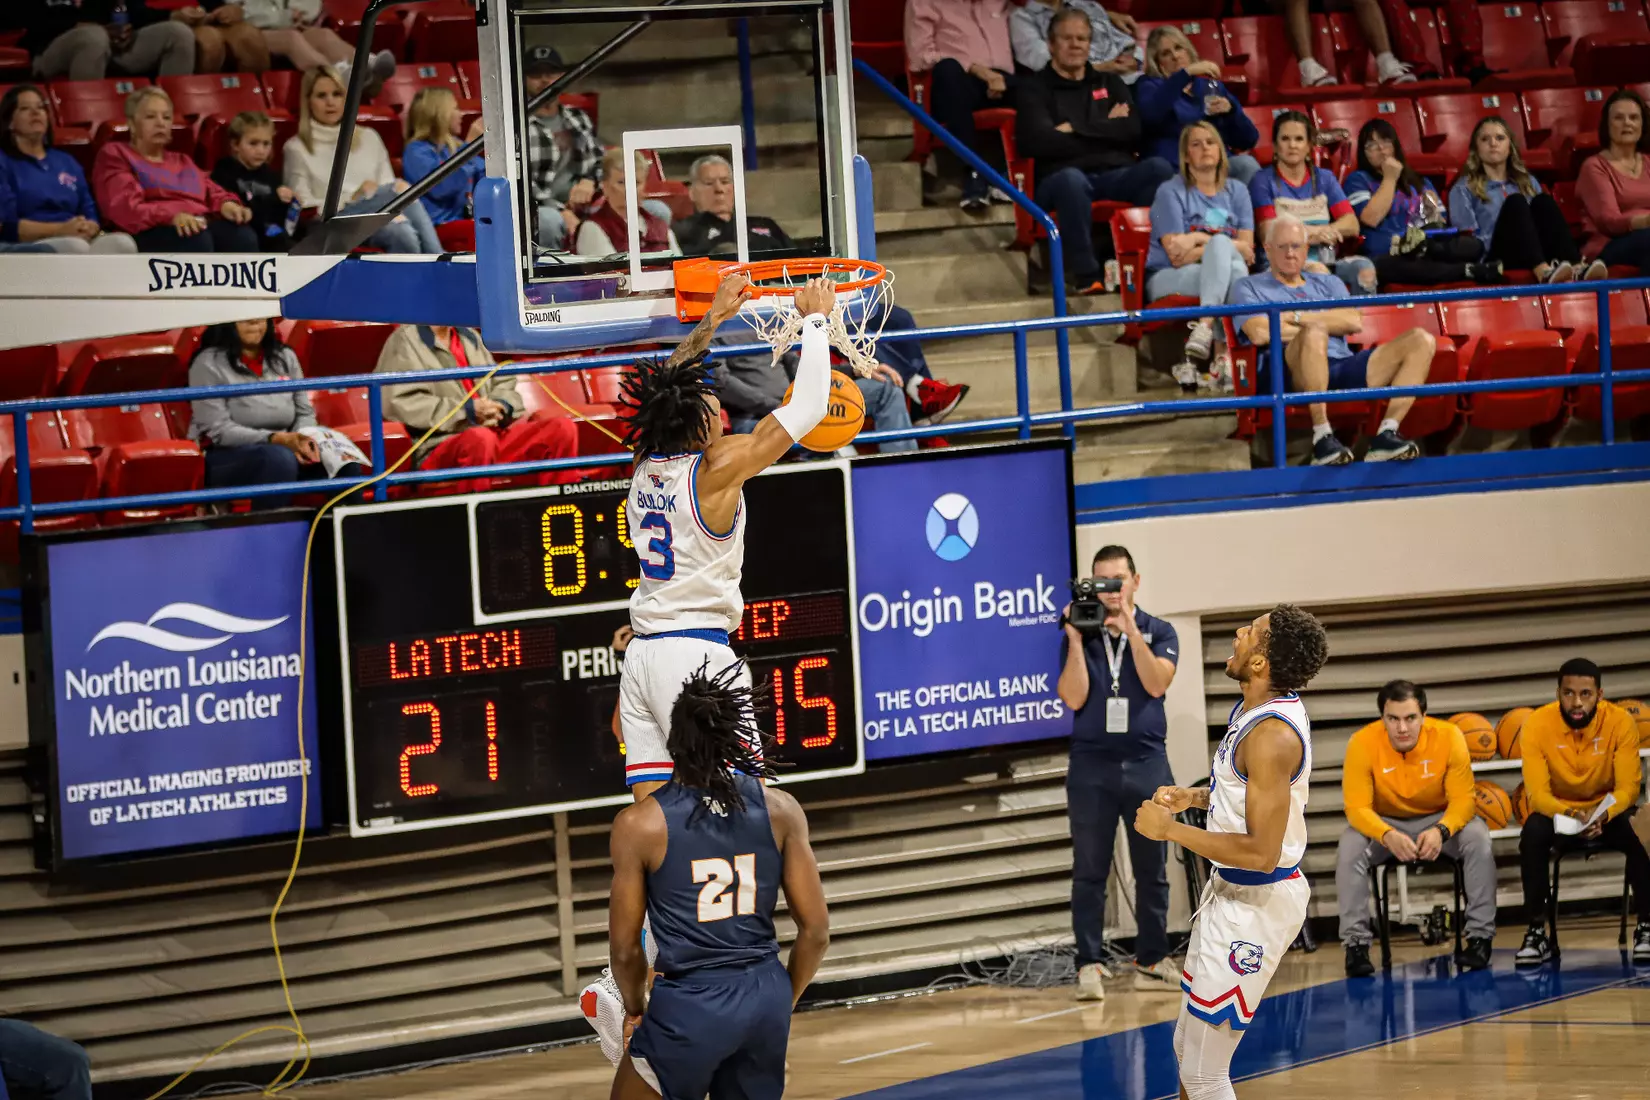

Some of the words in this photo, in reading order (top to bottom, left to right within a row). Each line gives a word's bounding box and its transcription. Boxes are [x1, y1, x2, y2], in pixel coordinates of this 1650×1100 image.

[148, 257, 277, 293] SPALDING
[524, 309, 561, 326] SPALDING
[563, 478, 634, 495] DAKTRONIC
[639, 511, 676, 581] 3
[859, 586, 964, 638] Origin
[973, 573, 1057, 620] Bank
[65, 661, 181, 700] Northern
[187, 648, 302, 687] Louisiana
[389, 628, 521, 680] LATECH
[89, 693, 190, 737] Medical
[195, 690, 282, 726] Center
[773, 656, 837, 749] 15
[875, 688, 912, 712] THE
[915, 679, 996, 708] OFFICIAL
[999, 673, 1050, 698] BANK
[864, 719, 890, 741] OF
[894, 716, 918, 738] LA
[919, 711, 968, 735] TECH
[971, 698, 1065, 729] ATHLETICS
[400, 701, 498, 797] 21
[66, 777, 147, 803] OFFICIAL
[149, 767, 223, 793] IMAGING
[225, 758, 312, 784] PROVIDER
[90, 807, 113, 826] OF
[115, 798, 187, 824] LATECH
[188, 785, 288, 814] ATHLETICS
[690, 852, 757, 923] 21
